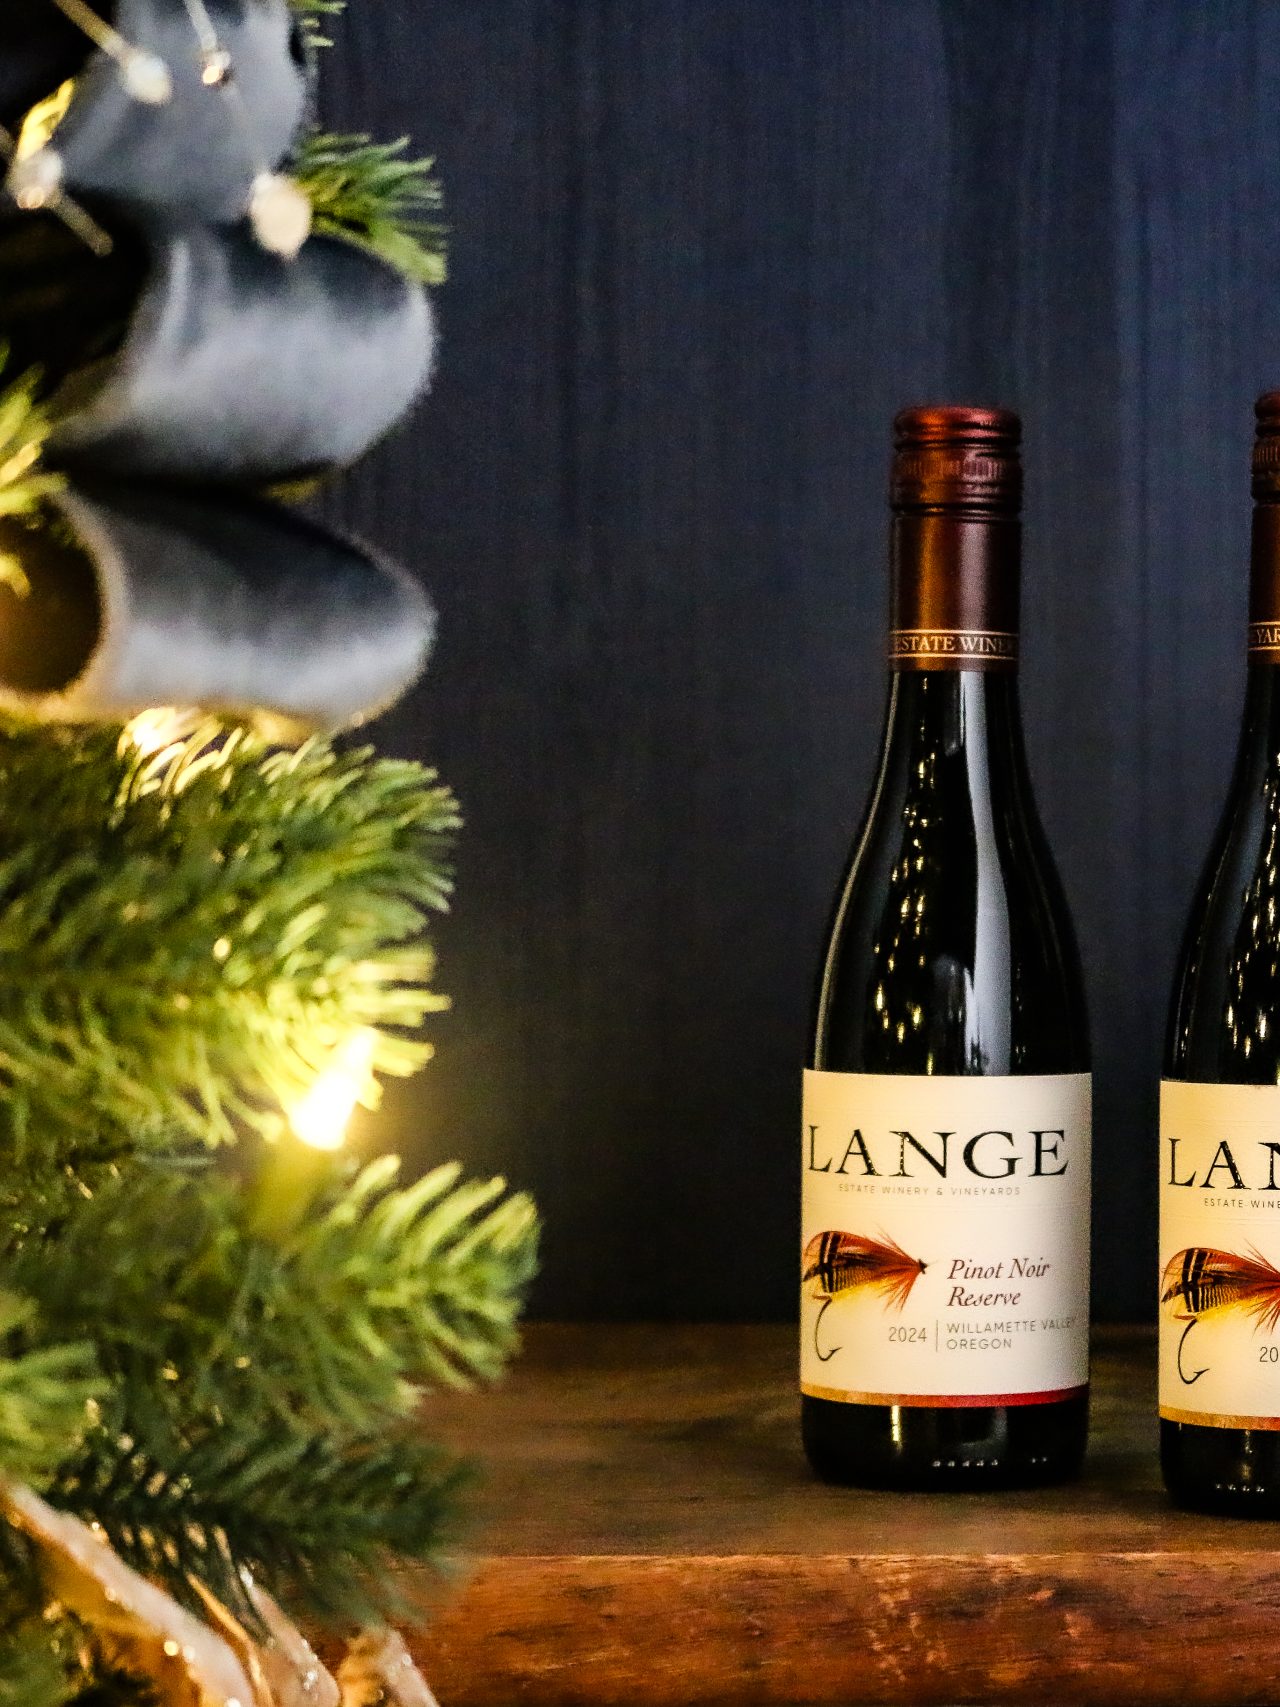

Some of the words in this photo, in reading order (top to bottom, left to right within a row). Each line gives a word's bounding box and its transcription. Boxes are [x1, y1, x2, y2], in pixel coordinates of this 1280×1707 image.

[808, 1124, 1069, 1179] LANGE
[838, 1183, 876, 1194] ESTATE
[882, 1185, 929, 1195] WINERY
[936, 1187, 943, 1196] &
[951, 1186, 1021, 1196] VINEYARDS
[1204, 1198, 1243, 1208] ESTATE
[947, 1258, 1004, 1280] Pinot
[1007, 1256, 1051, 1279] Noir
[946, 1286, 1022, 1307] Reserve
[888, 1326, 928, 1343] 2024
[946, 1320, 1036, 1334] WILLAMETTE
[946, 1338, 1012, 1350] OREGON
